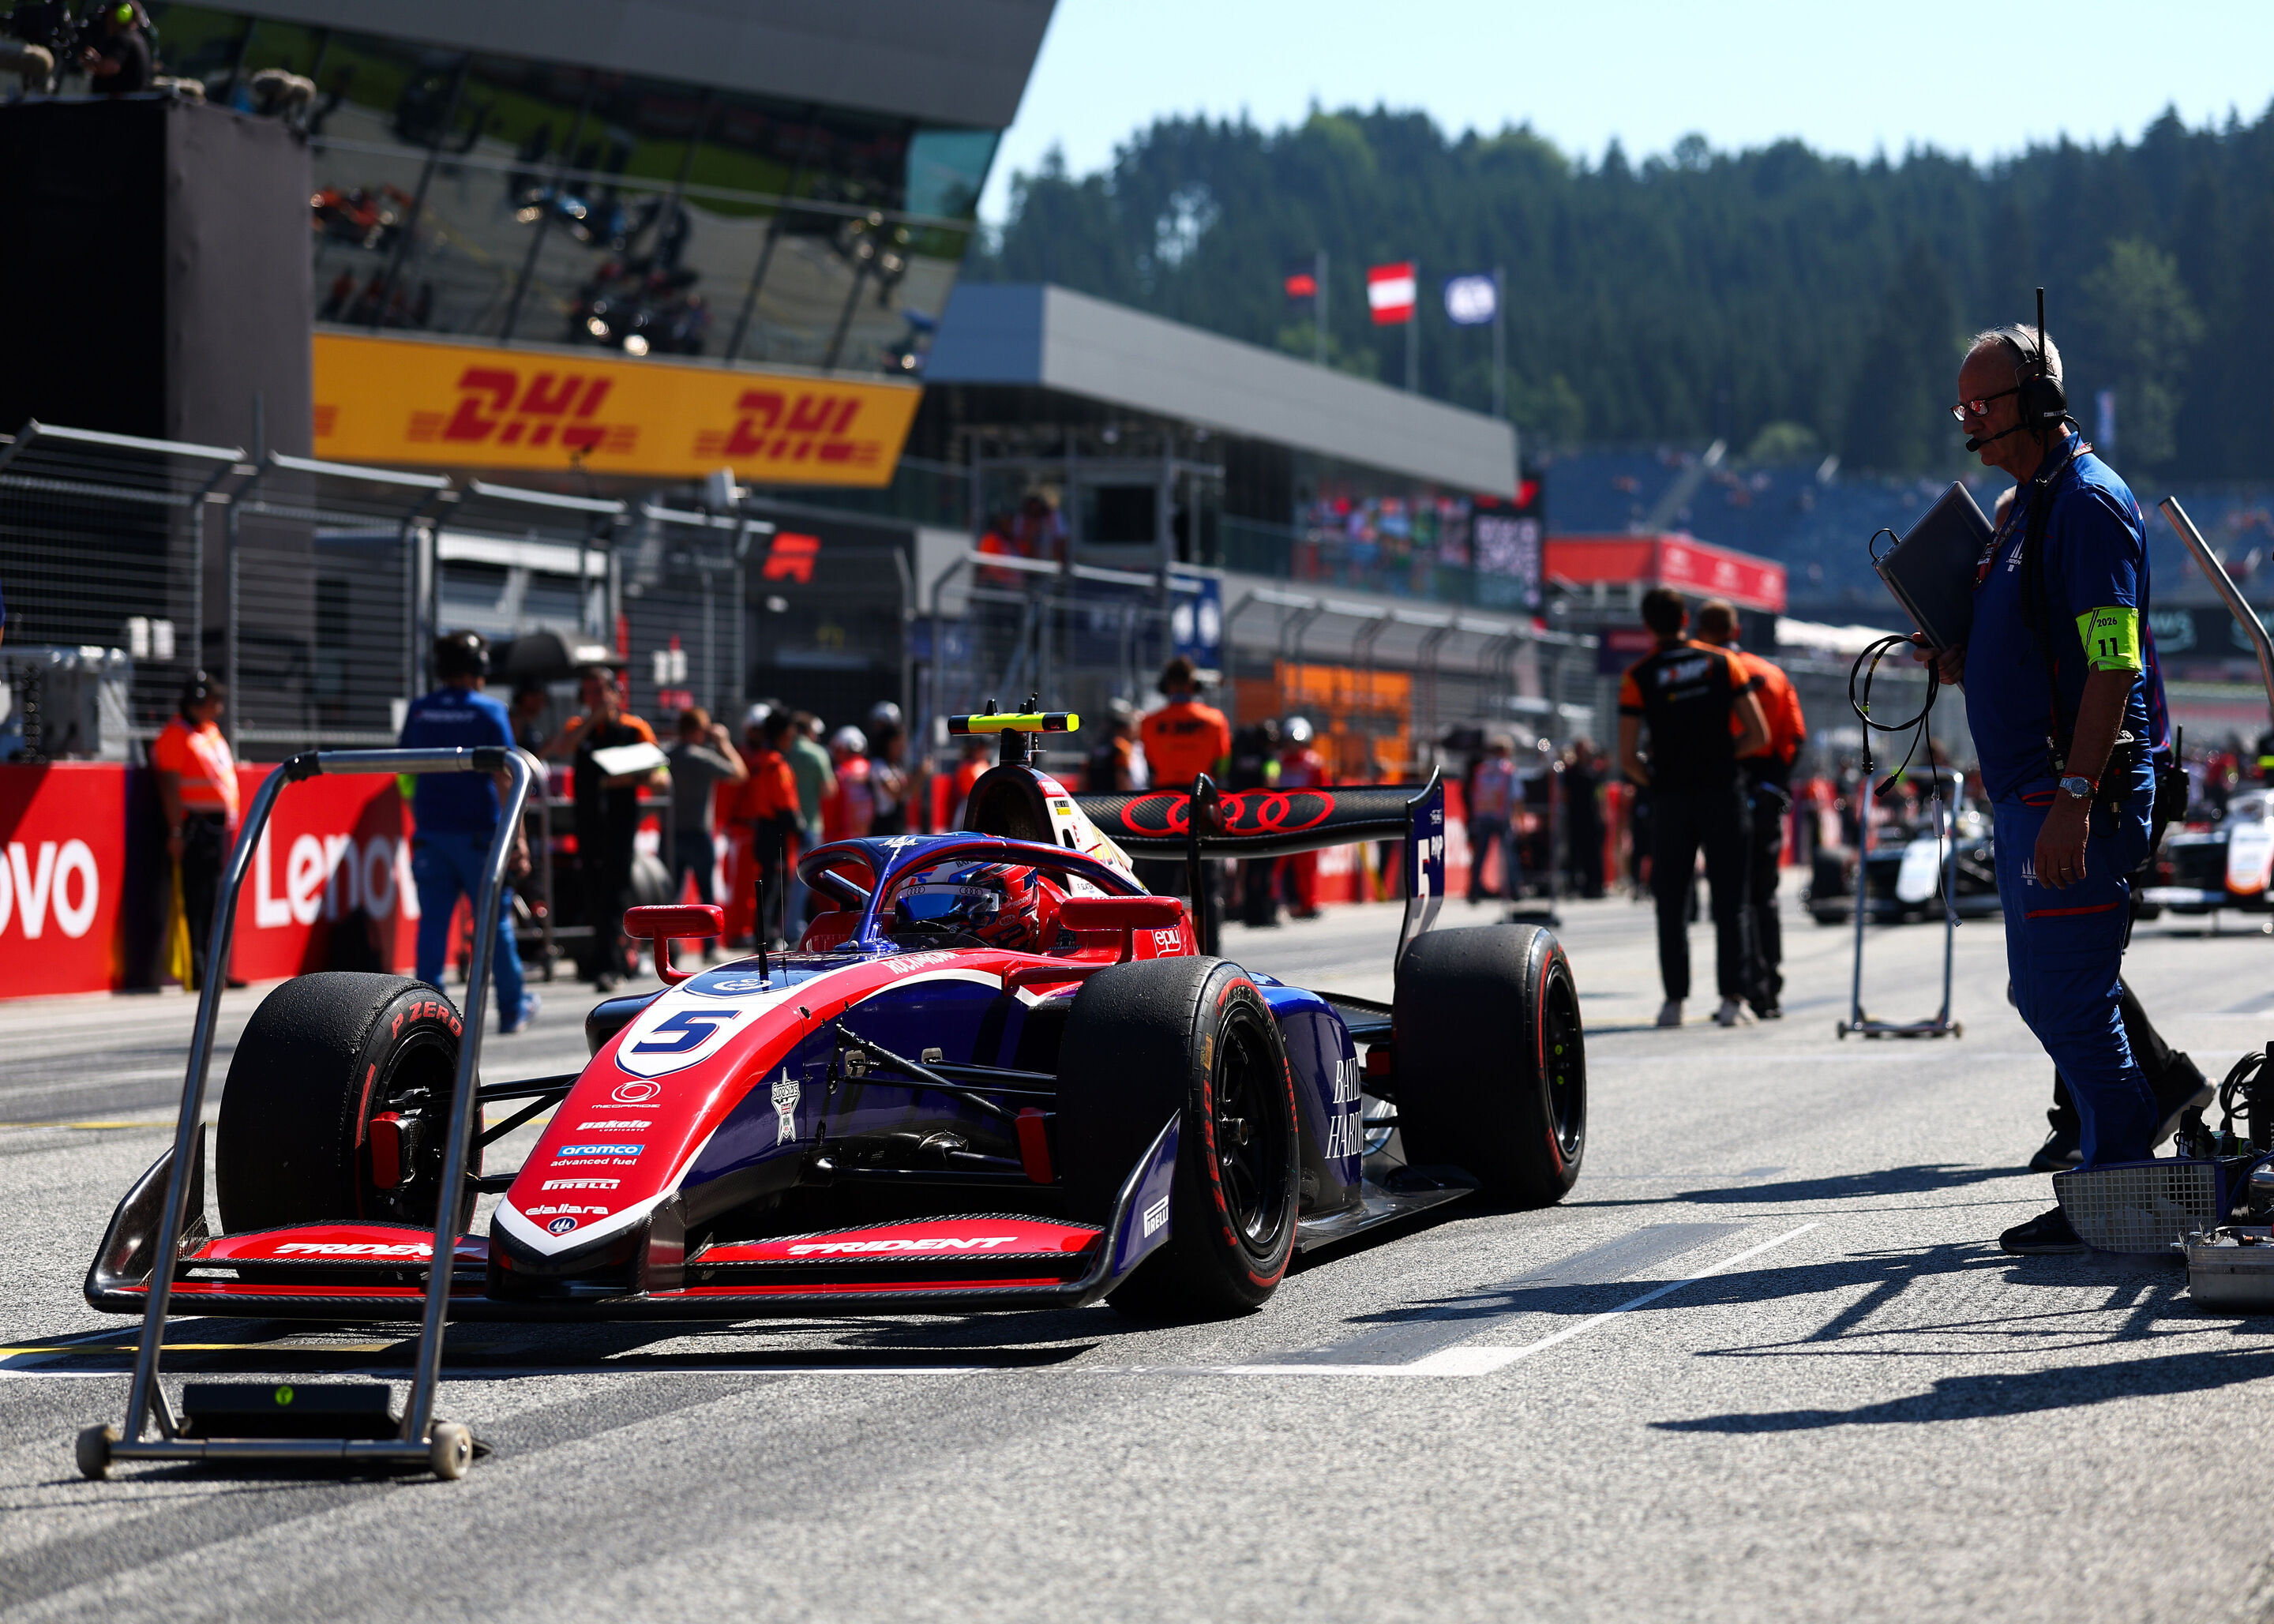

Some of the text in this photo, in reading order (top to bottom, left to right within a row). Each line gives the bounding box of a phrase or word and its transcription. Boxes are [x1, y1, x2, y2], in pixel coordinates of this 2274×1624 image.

[443, 367, 614, 450] DHL
[723, 389, 864, 464] DHL
[2096, 617, 2118, 628] 2026
[2097, 637, 2118, 657] 11
[1407, 838, 1431, 941] 5
[391, 1001, 463, 1040] P ZERO
[631, 1010, 741, 1054] 5
[1333, 1057, 1362, 1104] BAYL
[576, 1120, 652, 1131] pakelo
[1324, 1111, 1363, 1159] HARD
[550, 1157, 637, 1167] advanced fuel
[562, 1146, 638, 1155] aramco
[541, 1178, 621, 1191] PIRELLI
[525, 1204, 609, 1216] dallara
[1143, 1195, 1169, 1238] PIRELLI
[787, 1236, 1019, 1256] TRIDENT
